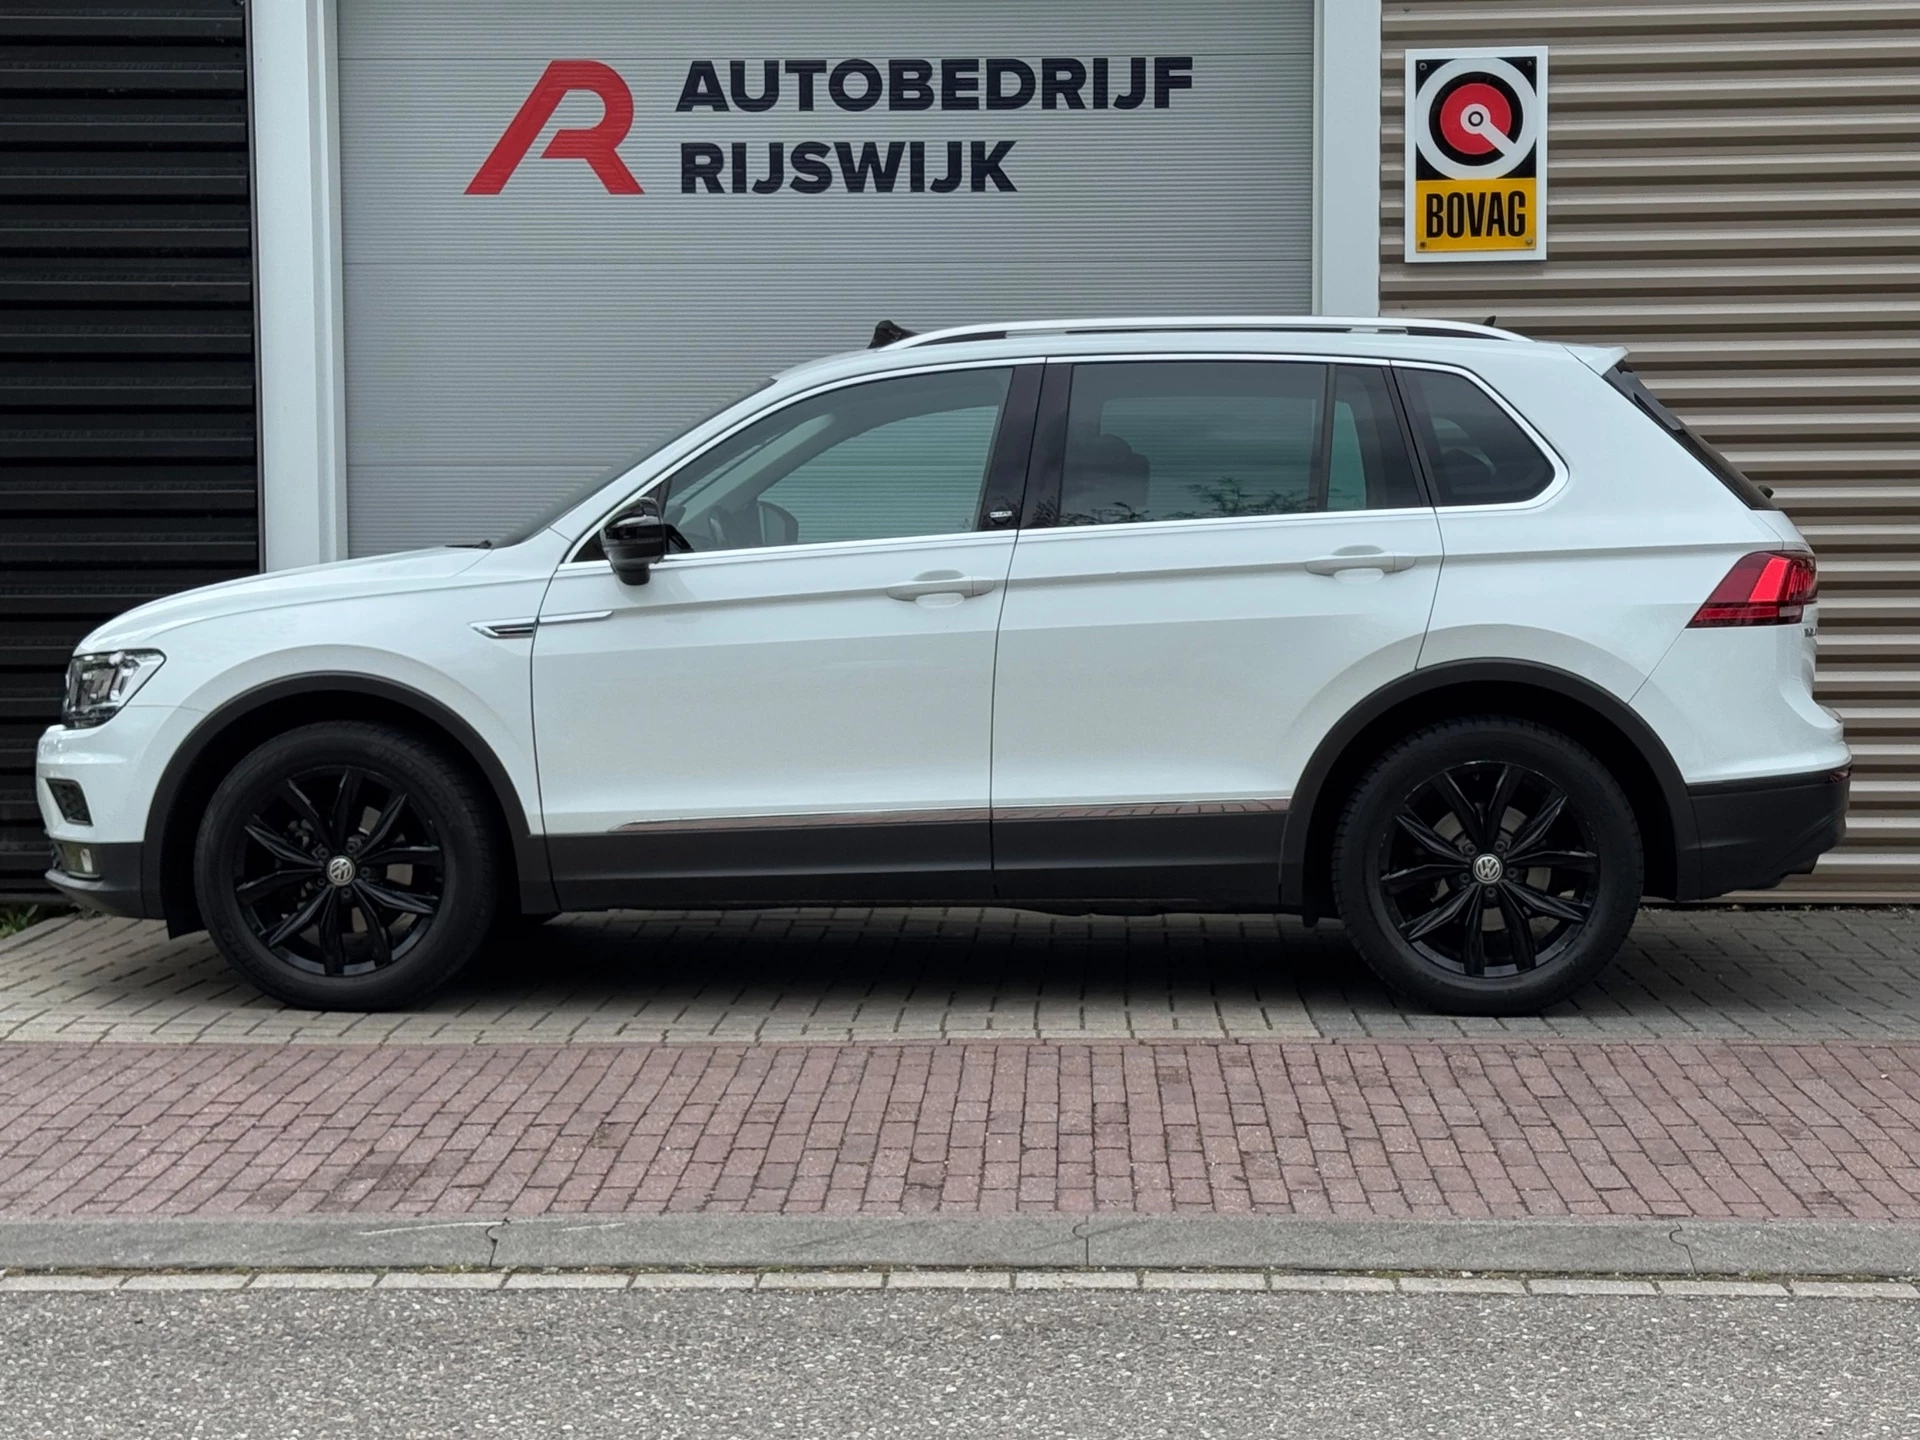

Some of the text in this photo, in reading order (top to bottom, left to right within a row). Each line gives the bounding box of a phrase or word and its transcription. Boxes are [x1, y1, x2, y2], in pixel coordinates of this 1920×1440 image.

[676, 56, 1193, 113] AUTOBEDRIJF
[681, 141, 1017, 194] RIJSWIJK
[1426, 190, 1527, 239] BOVAG
